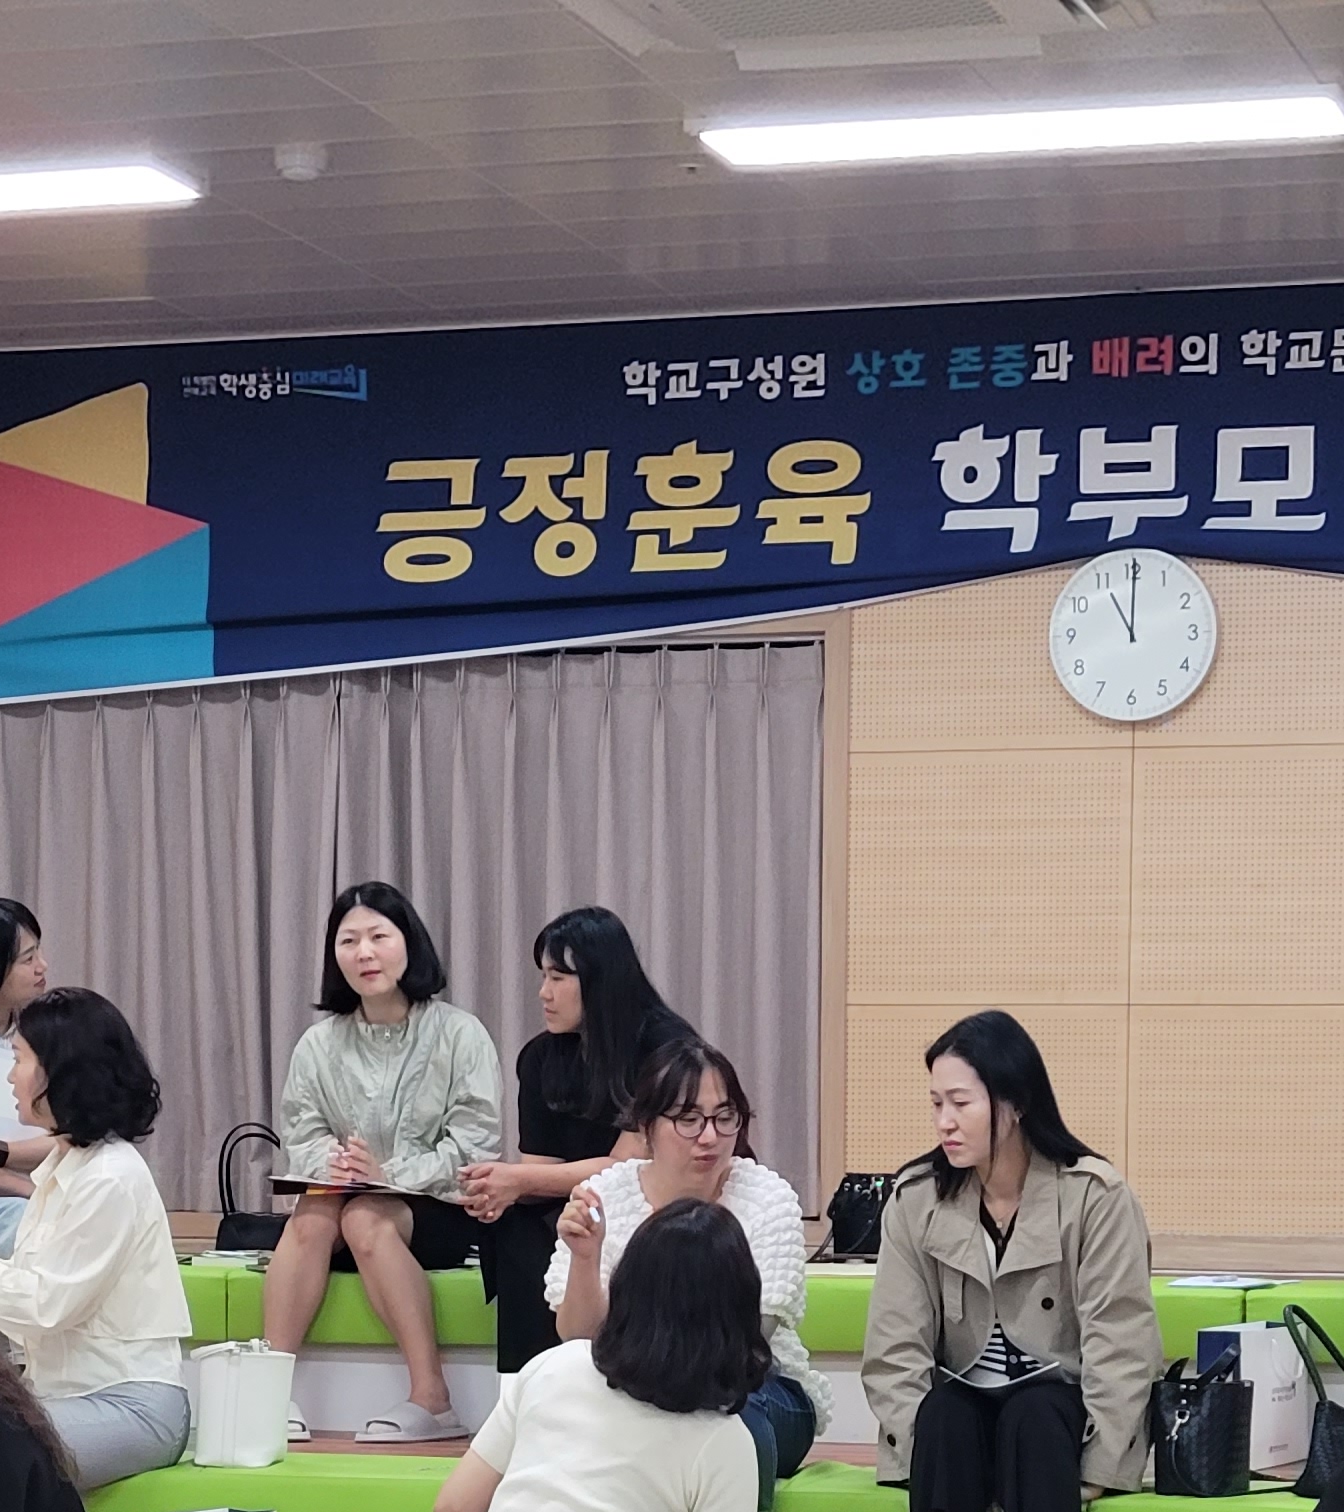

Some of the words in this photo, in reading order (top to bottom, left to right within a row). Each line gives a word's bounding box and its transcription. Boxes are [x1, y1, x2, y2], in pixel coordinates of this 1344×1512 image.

[623, 353, 826, 404] 학교구성원
[846, 348, 927, 395] 상호
[947, 340, 1073, 390] 존중과
[1092, 333, 1219, 379] 배려의
[375, 437, 871, 583] 긍정훈육
[931, 420, 1329, 553] 학부모
[1095, 572, 1110, 590] 11
[1071, 595, 1089, 614] 10
[1179, 592, 1192, 610] 2
[1065, 627, 1077, 645] 9
[1187, 623, 1199, 641] 3
[1073, 658, 1085, 676] 8
[1179, 656, 1190, 673] 4
[1095, 680, 1107, 698] 7
[1156, 679, 1168, 696] 5
[1126, 688, 1137, 706] 6
